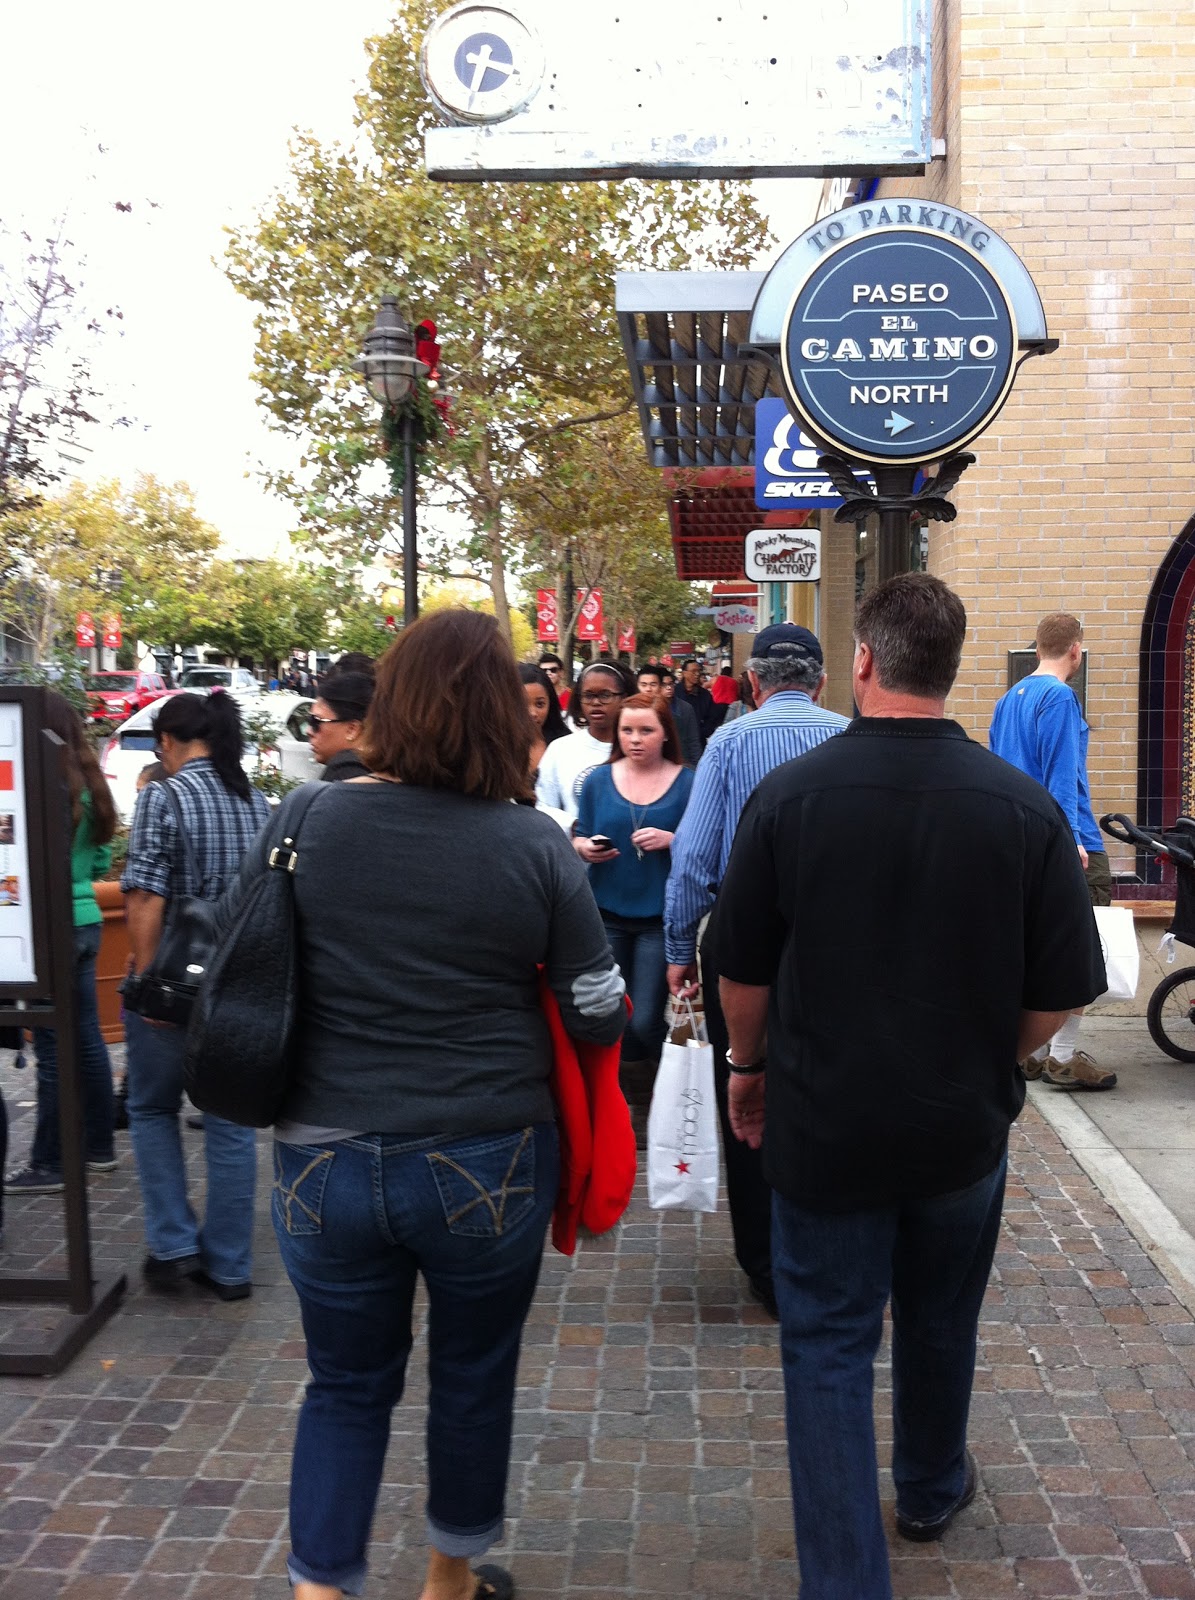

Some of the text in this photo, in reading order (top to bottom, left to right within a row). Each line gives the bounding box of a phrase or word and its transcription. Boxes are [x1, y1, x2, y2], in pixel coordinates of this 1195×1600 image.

[806, 204, 990, 252] TO PARKING
[852, 283, 949, 303] PASEO
[880, 315, 918, 332] EL
[801, 335, 998, 362] CAMINO
[850, 385, 949, 404] NORTH
[754, 552, 817, 567] CHOCOLATE
[766, 562, 814, 577] FACTORY
[717, 611, 756, 626] Justice
